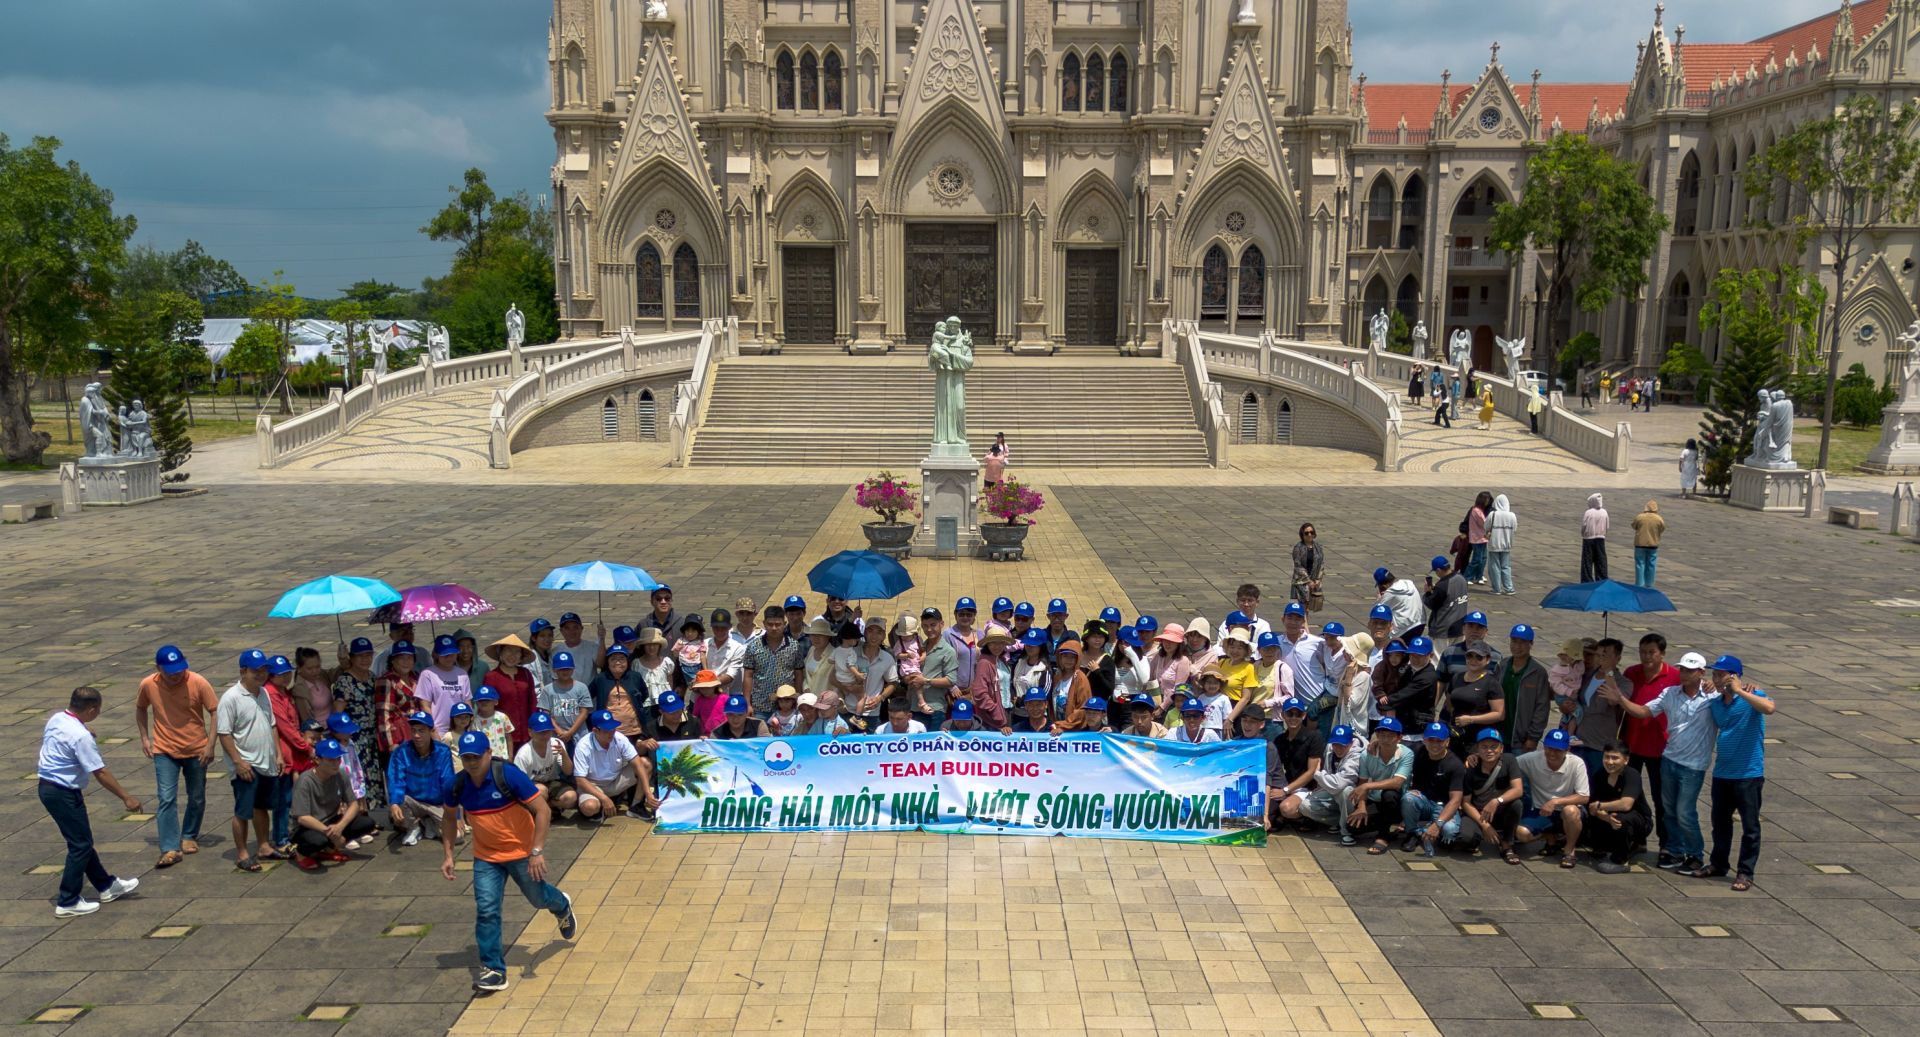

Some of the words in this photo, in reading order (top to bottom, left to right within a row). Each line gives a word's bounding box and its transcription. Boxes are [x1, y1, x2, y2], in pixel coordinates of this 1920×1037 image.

[819, 741, 862, 756] CÔNG
[865, 742, 884, 754] TY
[887, 738, 909, 753] CỔ
[912, 737, 954, 752] PHẦN
[958, 738, 1003, 752] ĐÔNG
[1007, 738, 1033, 753] HẢI
[1037, 738, 1068, 753] BẾN
[1072, 742, 1101, 753] TRE
[879, 762, 936, 778] TEAM
[941, 761, 1040, 778] BUILDING
[700, 789, 773, 828] ĐÔNG
[778, 783, 824, 827] HẢI
[889, 783, 940, 825] NHÀ
[1034, 785, 1105, 830] SÓNG
[1112, 789, 1181, 830] VƯƠN
[1185, 794, 1221, 830] XA
